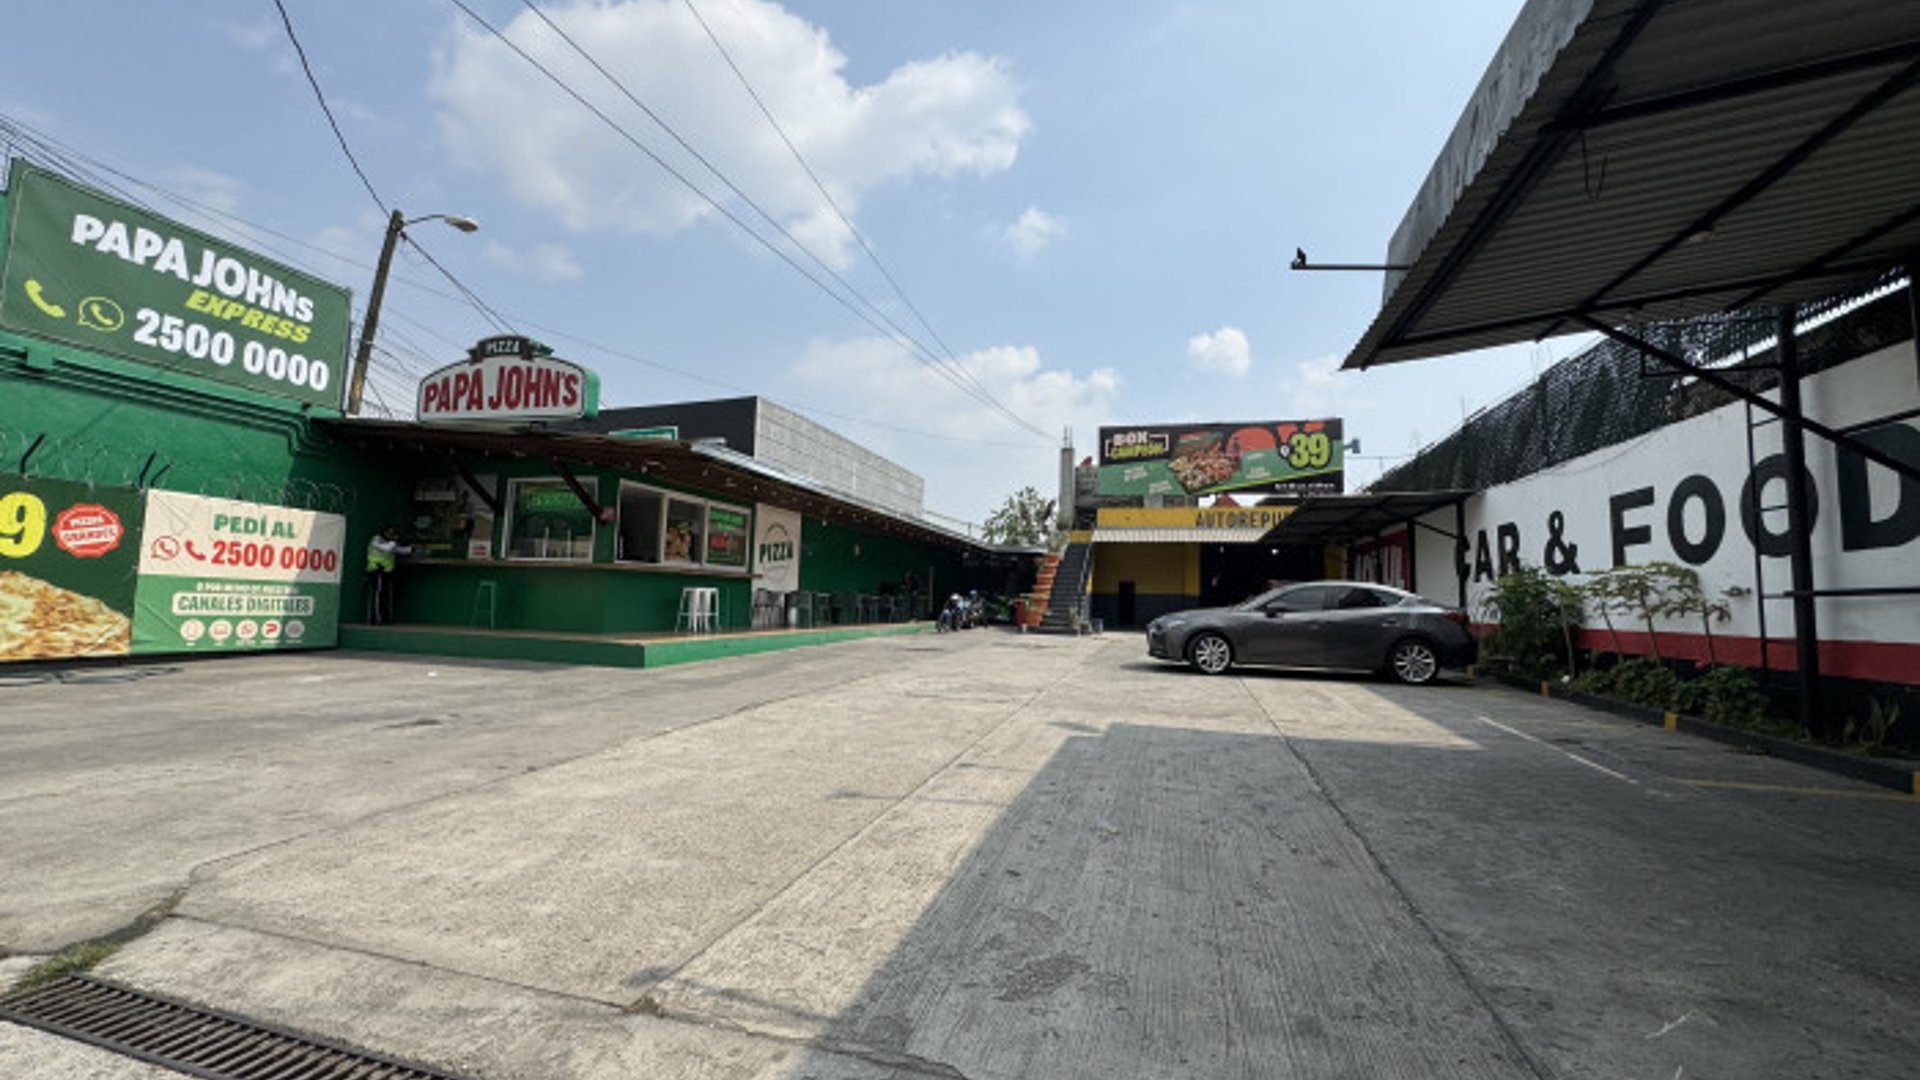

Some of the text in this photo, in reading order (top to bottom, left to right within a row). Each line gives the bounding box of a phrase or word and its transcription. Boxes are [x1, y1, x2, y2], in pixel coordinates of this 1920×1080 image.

[71, 214, 314, 322] PAPA JOHNS
[186, 289, 311, 343] EXPRESS
[134, 308, 329, 391] 2500 0000
[486, 339, 520, 354] PIZZA
[422, 365, 579, 413] PAPA JOHN'S
[1455, 522, 1520, 582] CAR
[1544, 510, 1580, 575] &
[1609, 423, 1920, 567] FOOD
[213, 513, 297, 540] PEDÍ AL
[211, 539, 336, 572] 2500 0000
[759, 541, 793, 564] PIZZA
[177, 595, 242, 611] CANALES
